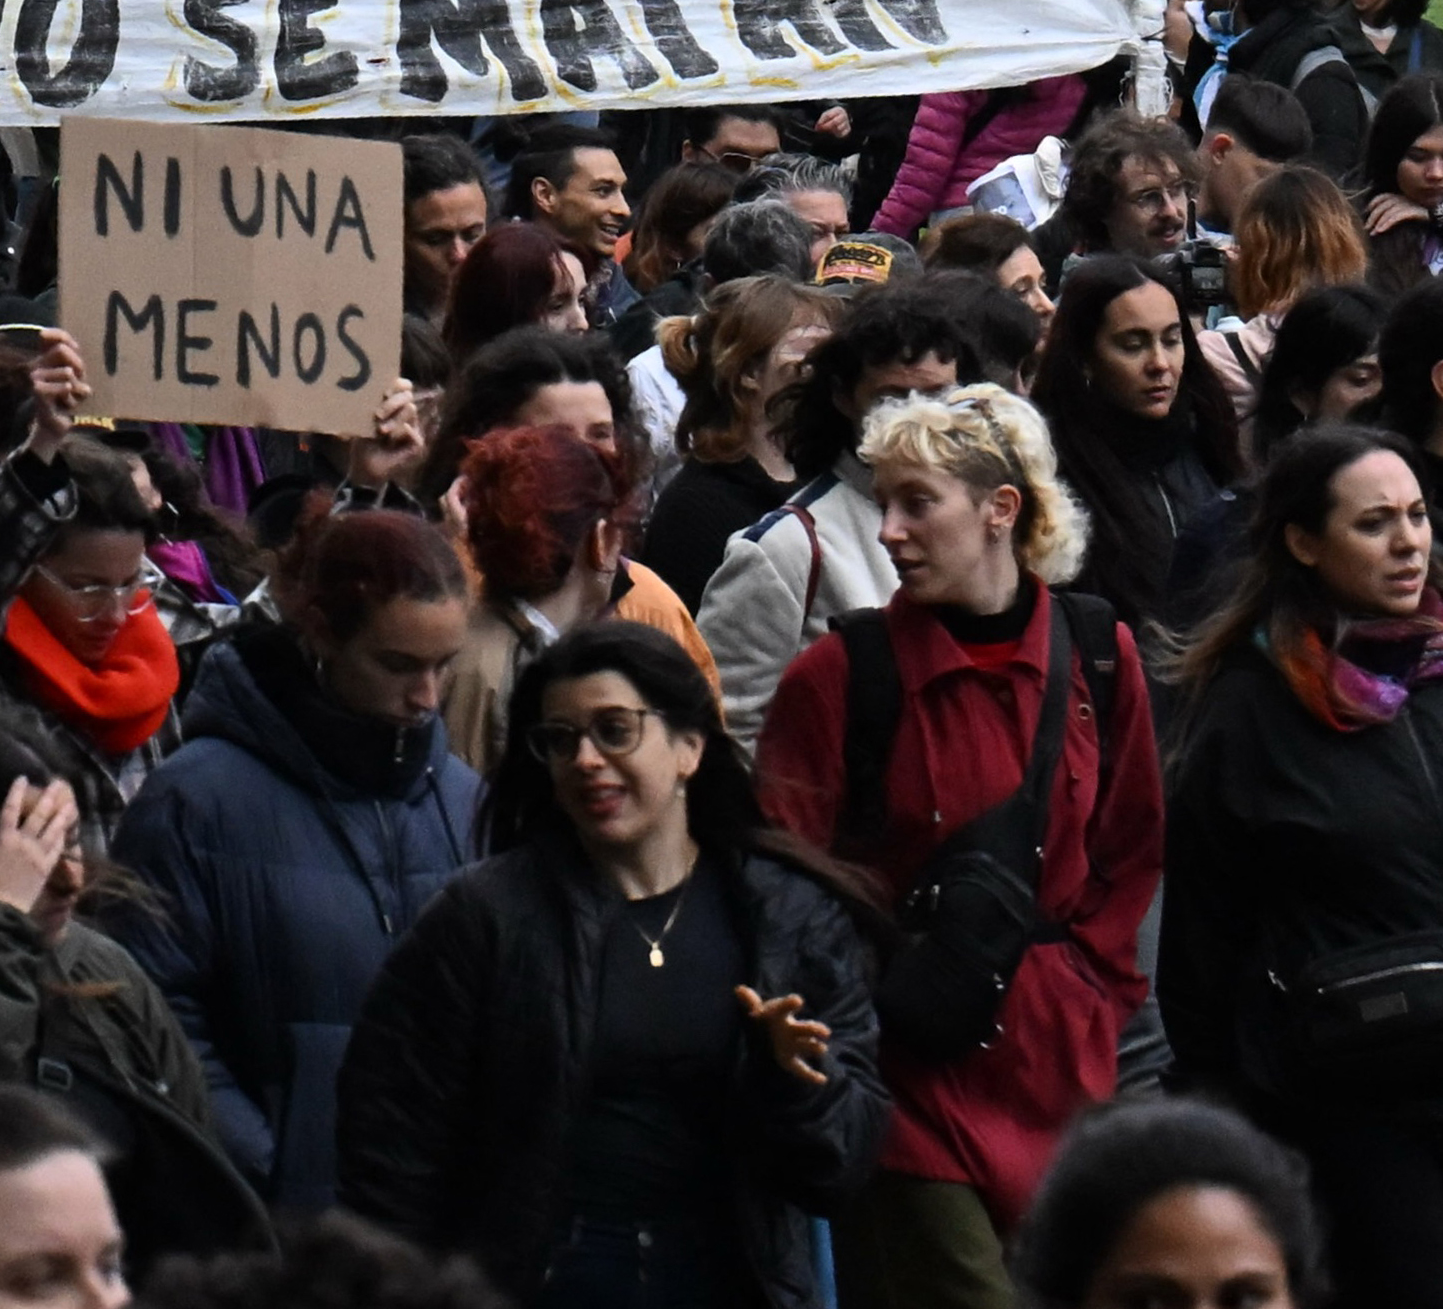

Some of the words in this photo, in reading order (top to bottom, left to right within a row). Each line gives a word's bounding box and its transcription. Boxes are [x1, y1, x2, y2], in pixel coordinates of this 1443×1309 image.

[94, 150, 181, 240] NI
[219, 164, 377, 262] UNA
[103, 291, 372, 391] MENOS
